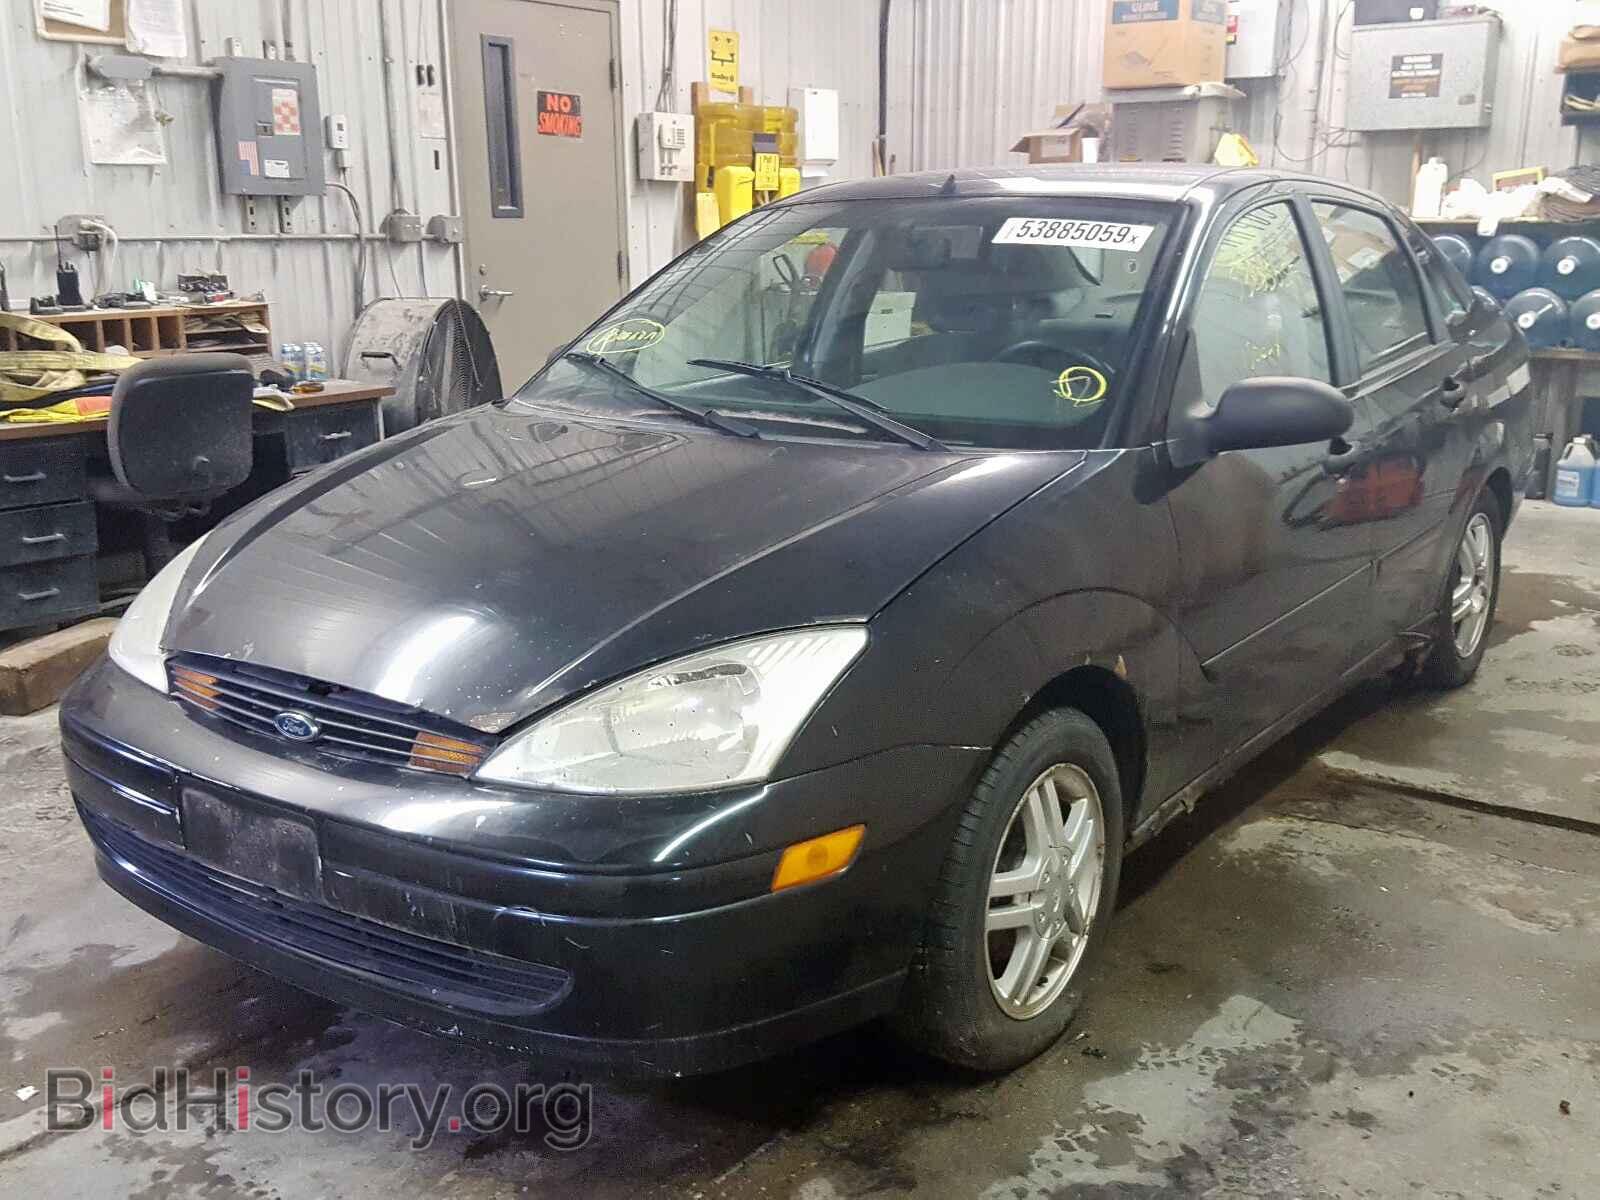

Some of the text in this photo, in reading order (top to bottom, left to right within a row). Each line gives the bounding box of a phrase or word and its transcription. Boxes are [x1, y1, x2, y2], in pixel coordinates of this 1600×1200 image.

[546, 94, 571, 113] NO
[539, 112, 581, 136] SMOKING
[282, 718, 305, 735] Ford
